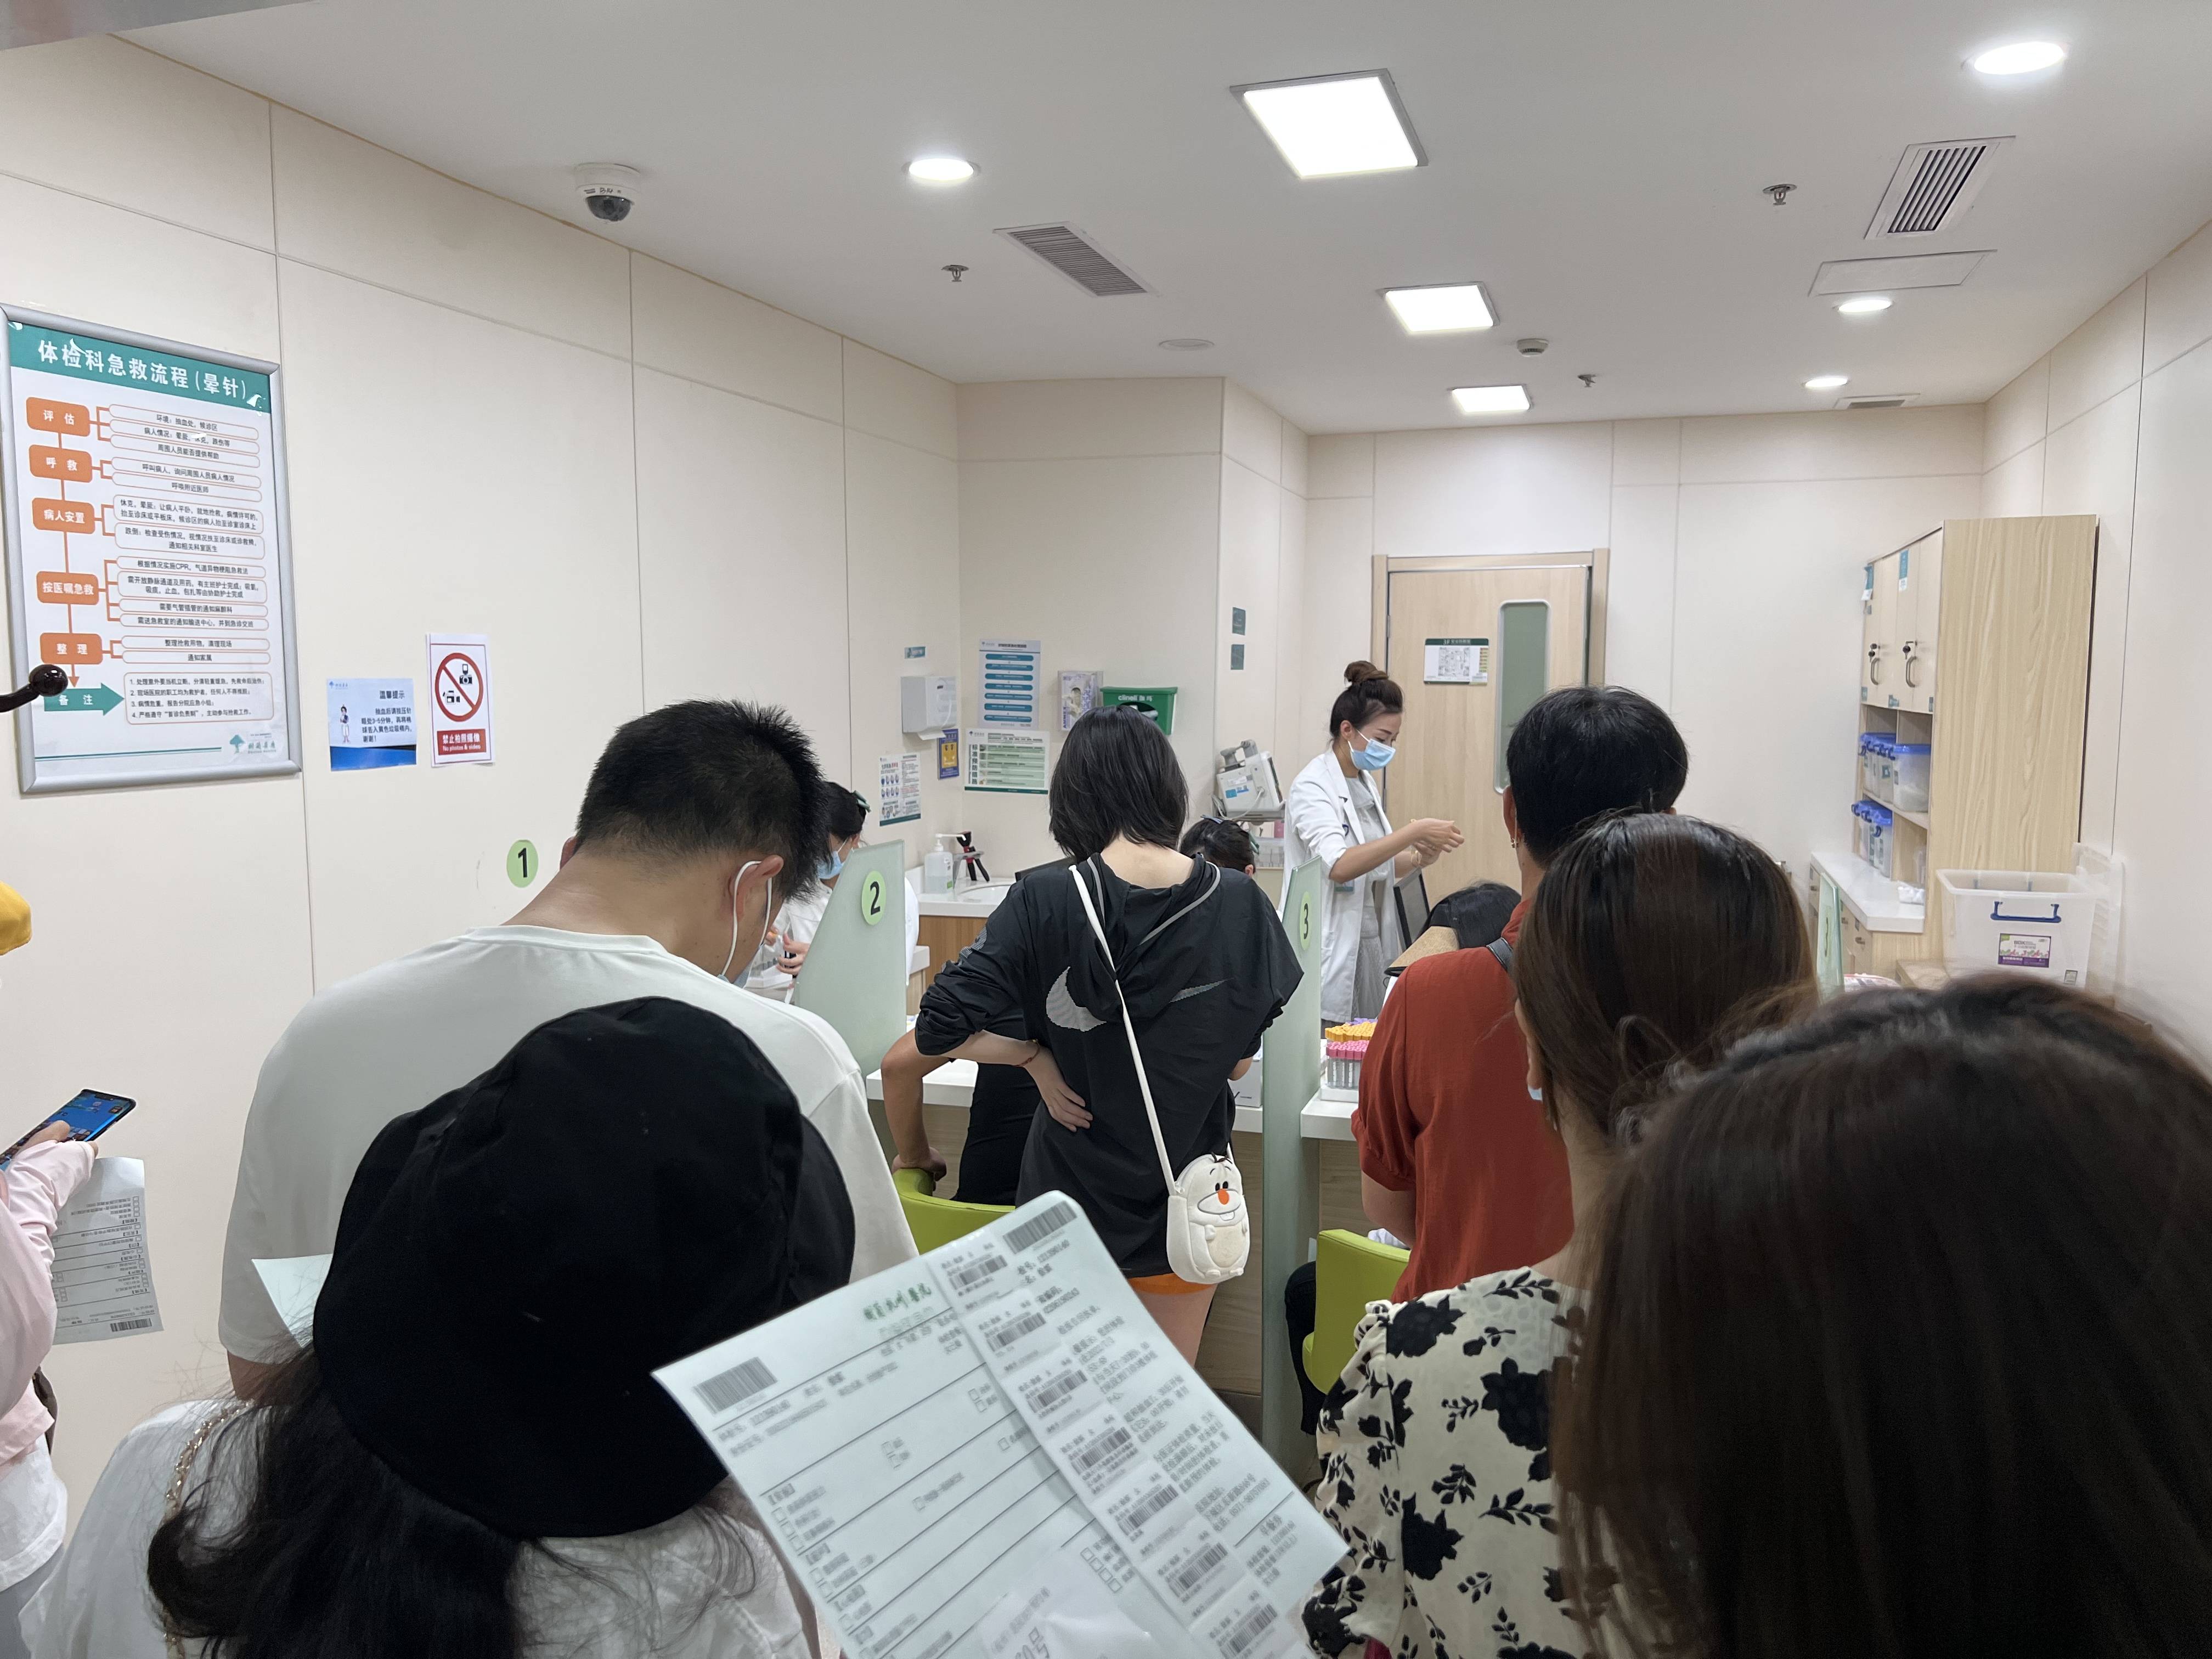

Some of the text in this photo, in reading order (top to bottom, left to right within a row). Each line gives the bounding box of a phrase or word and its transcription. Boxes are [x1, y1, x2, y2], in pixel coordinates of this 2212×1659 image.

[43, 509, 86, 524] 病人安置
[43, 581, 94, 596] 按医嘱急救
[517, 847, 528, 878] 1
[870, 880, 881, 916] 2
[1303, 903, 1310, 940] 3
